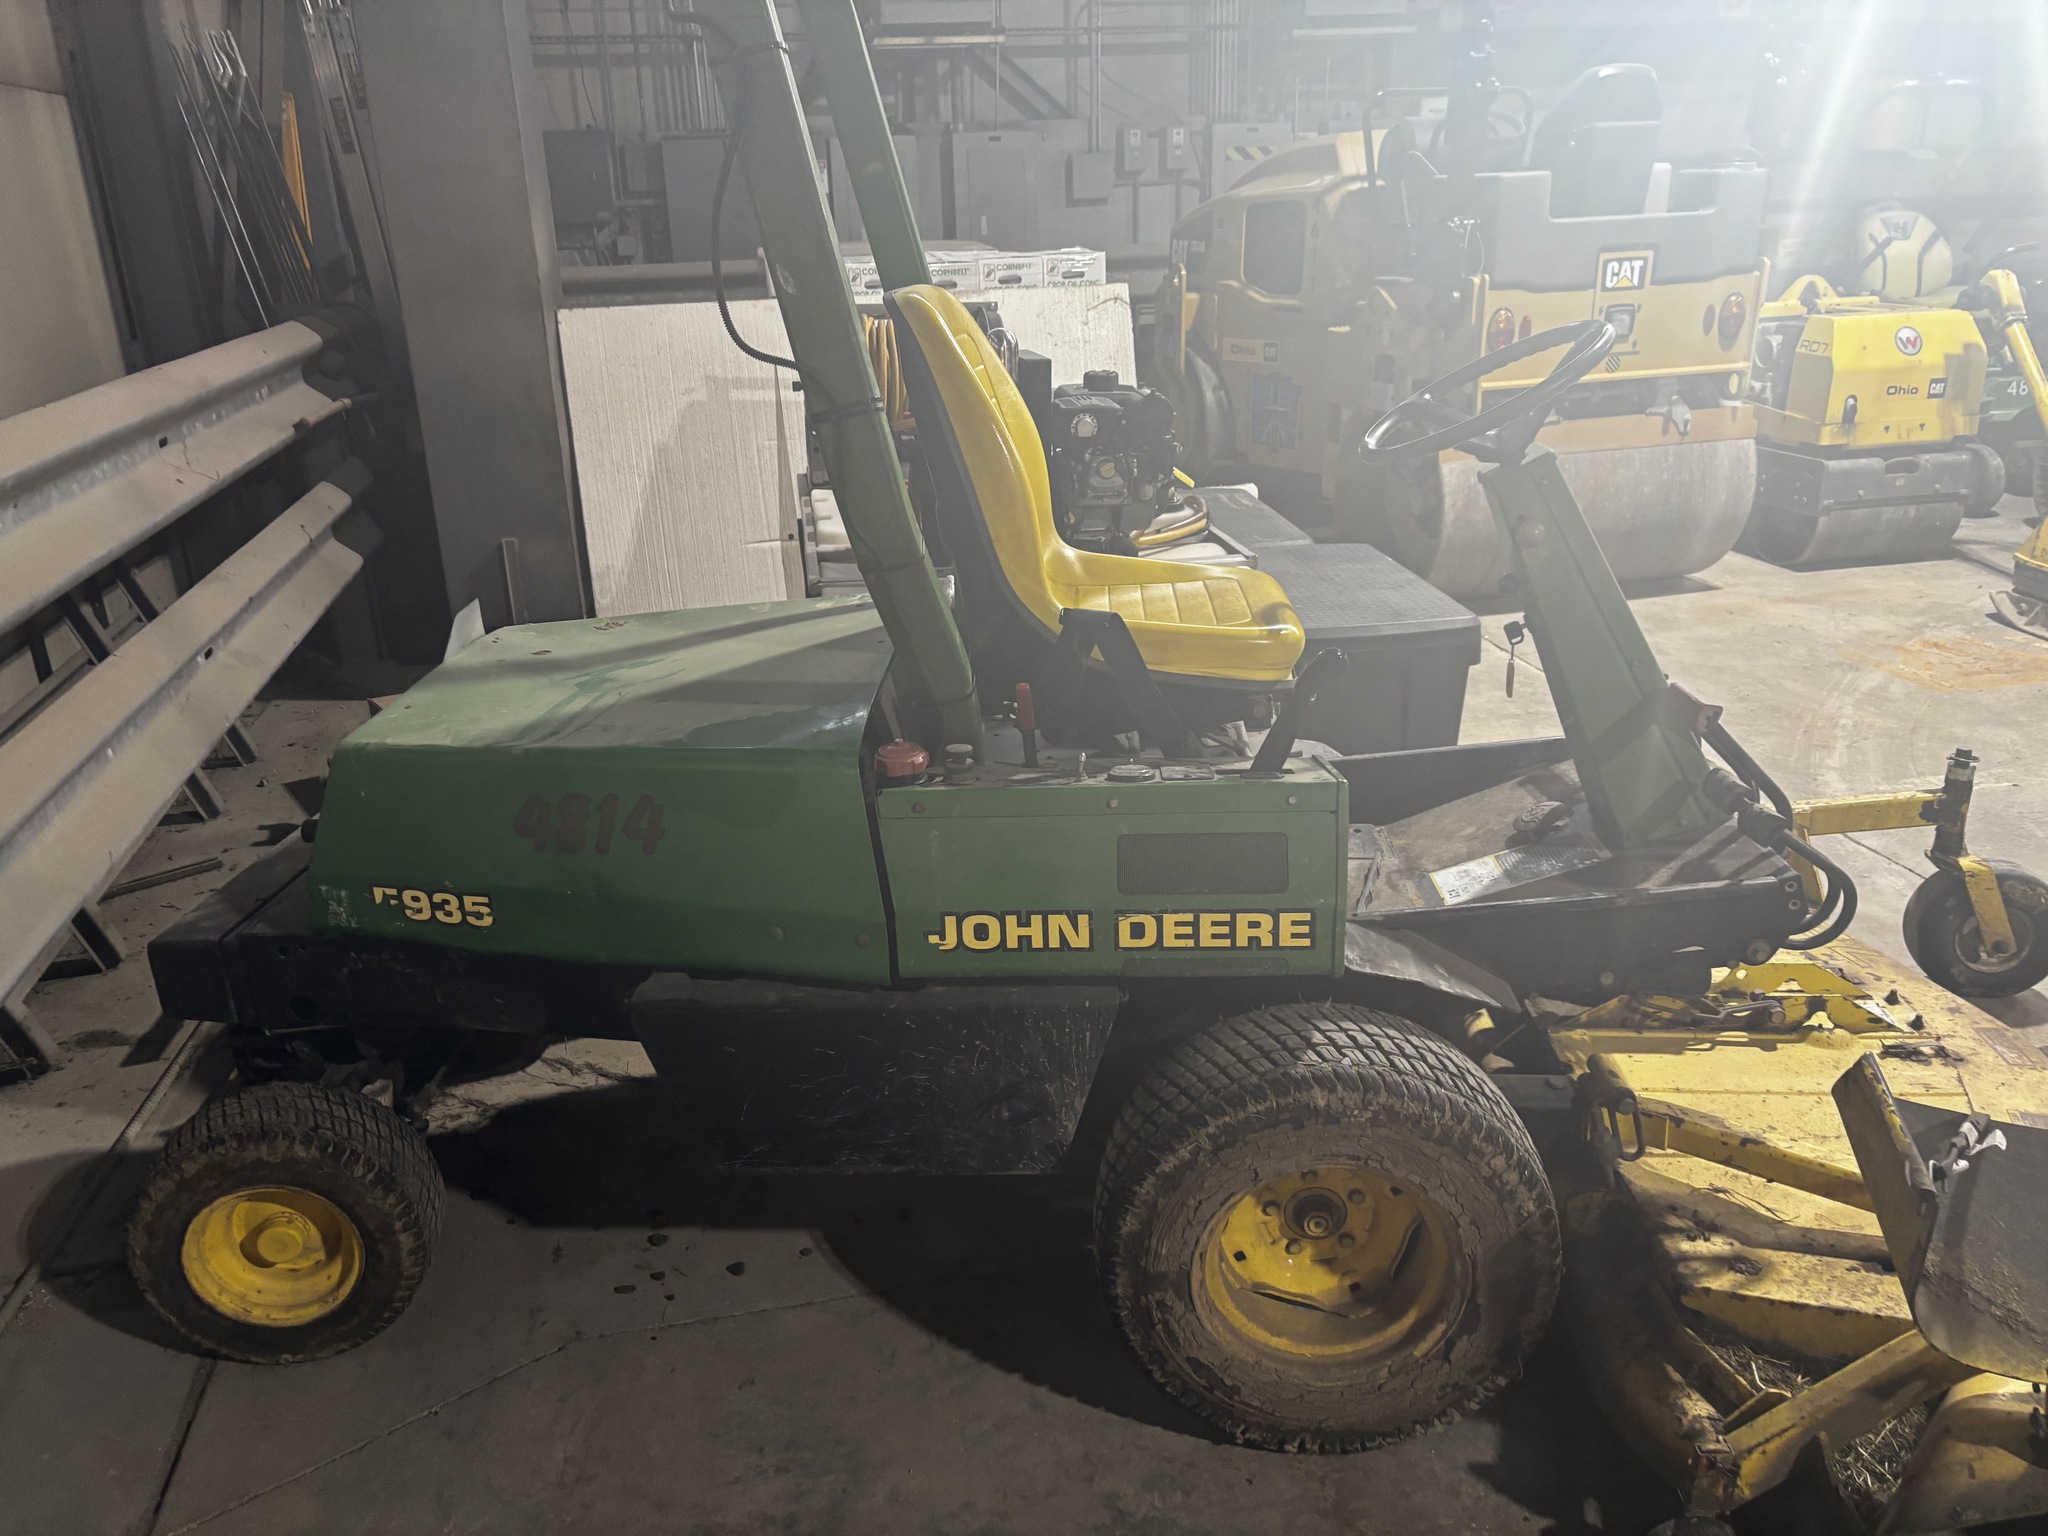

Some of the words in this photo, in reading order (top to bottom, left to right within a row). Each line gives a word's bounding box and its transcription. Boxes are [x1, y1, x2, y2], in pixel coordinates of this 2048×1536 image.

[1172, 239, 1188, 264] CAT
[931, 267, 969, 277] CORNBELT
[996, 262, 1032, 272] CORNBELT
[1605, 260, 1644, 289] CAT
[1231, 343, 1256, 356] Ohio
[1886, 384, 1919, 396] Ohio
[1930, 383, 1946, 394] CAT
[513, 792, 666, 855] 4814
[927, 913, 1091, 951] JOHN
[1118, 912, 1312, 949] DEERE
